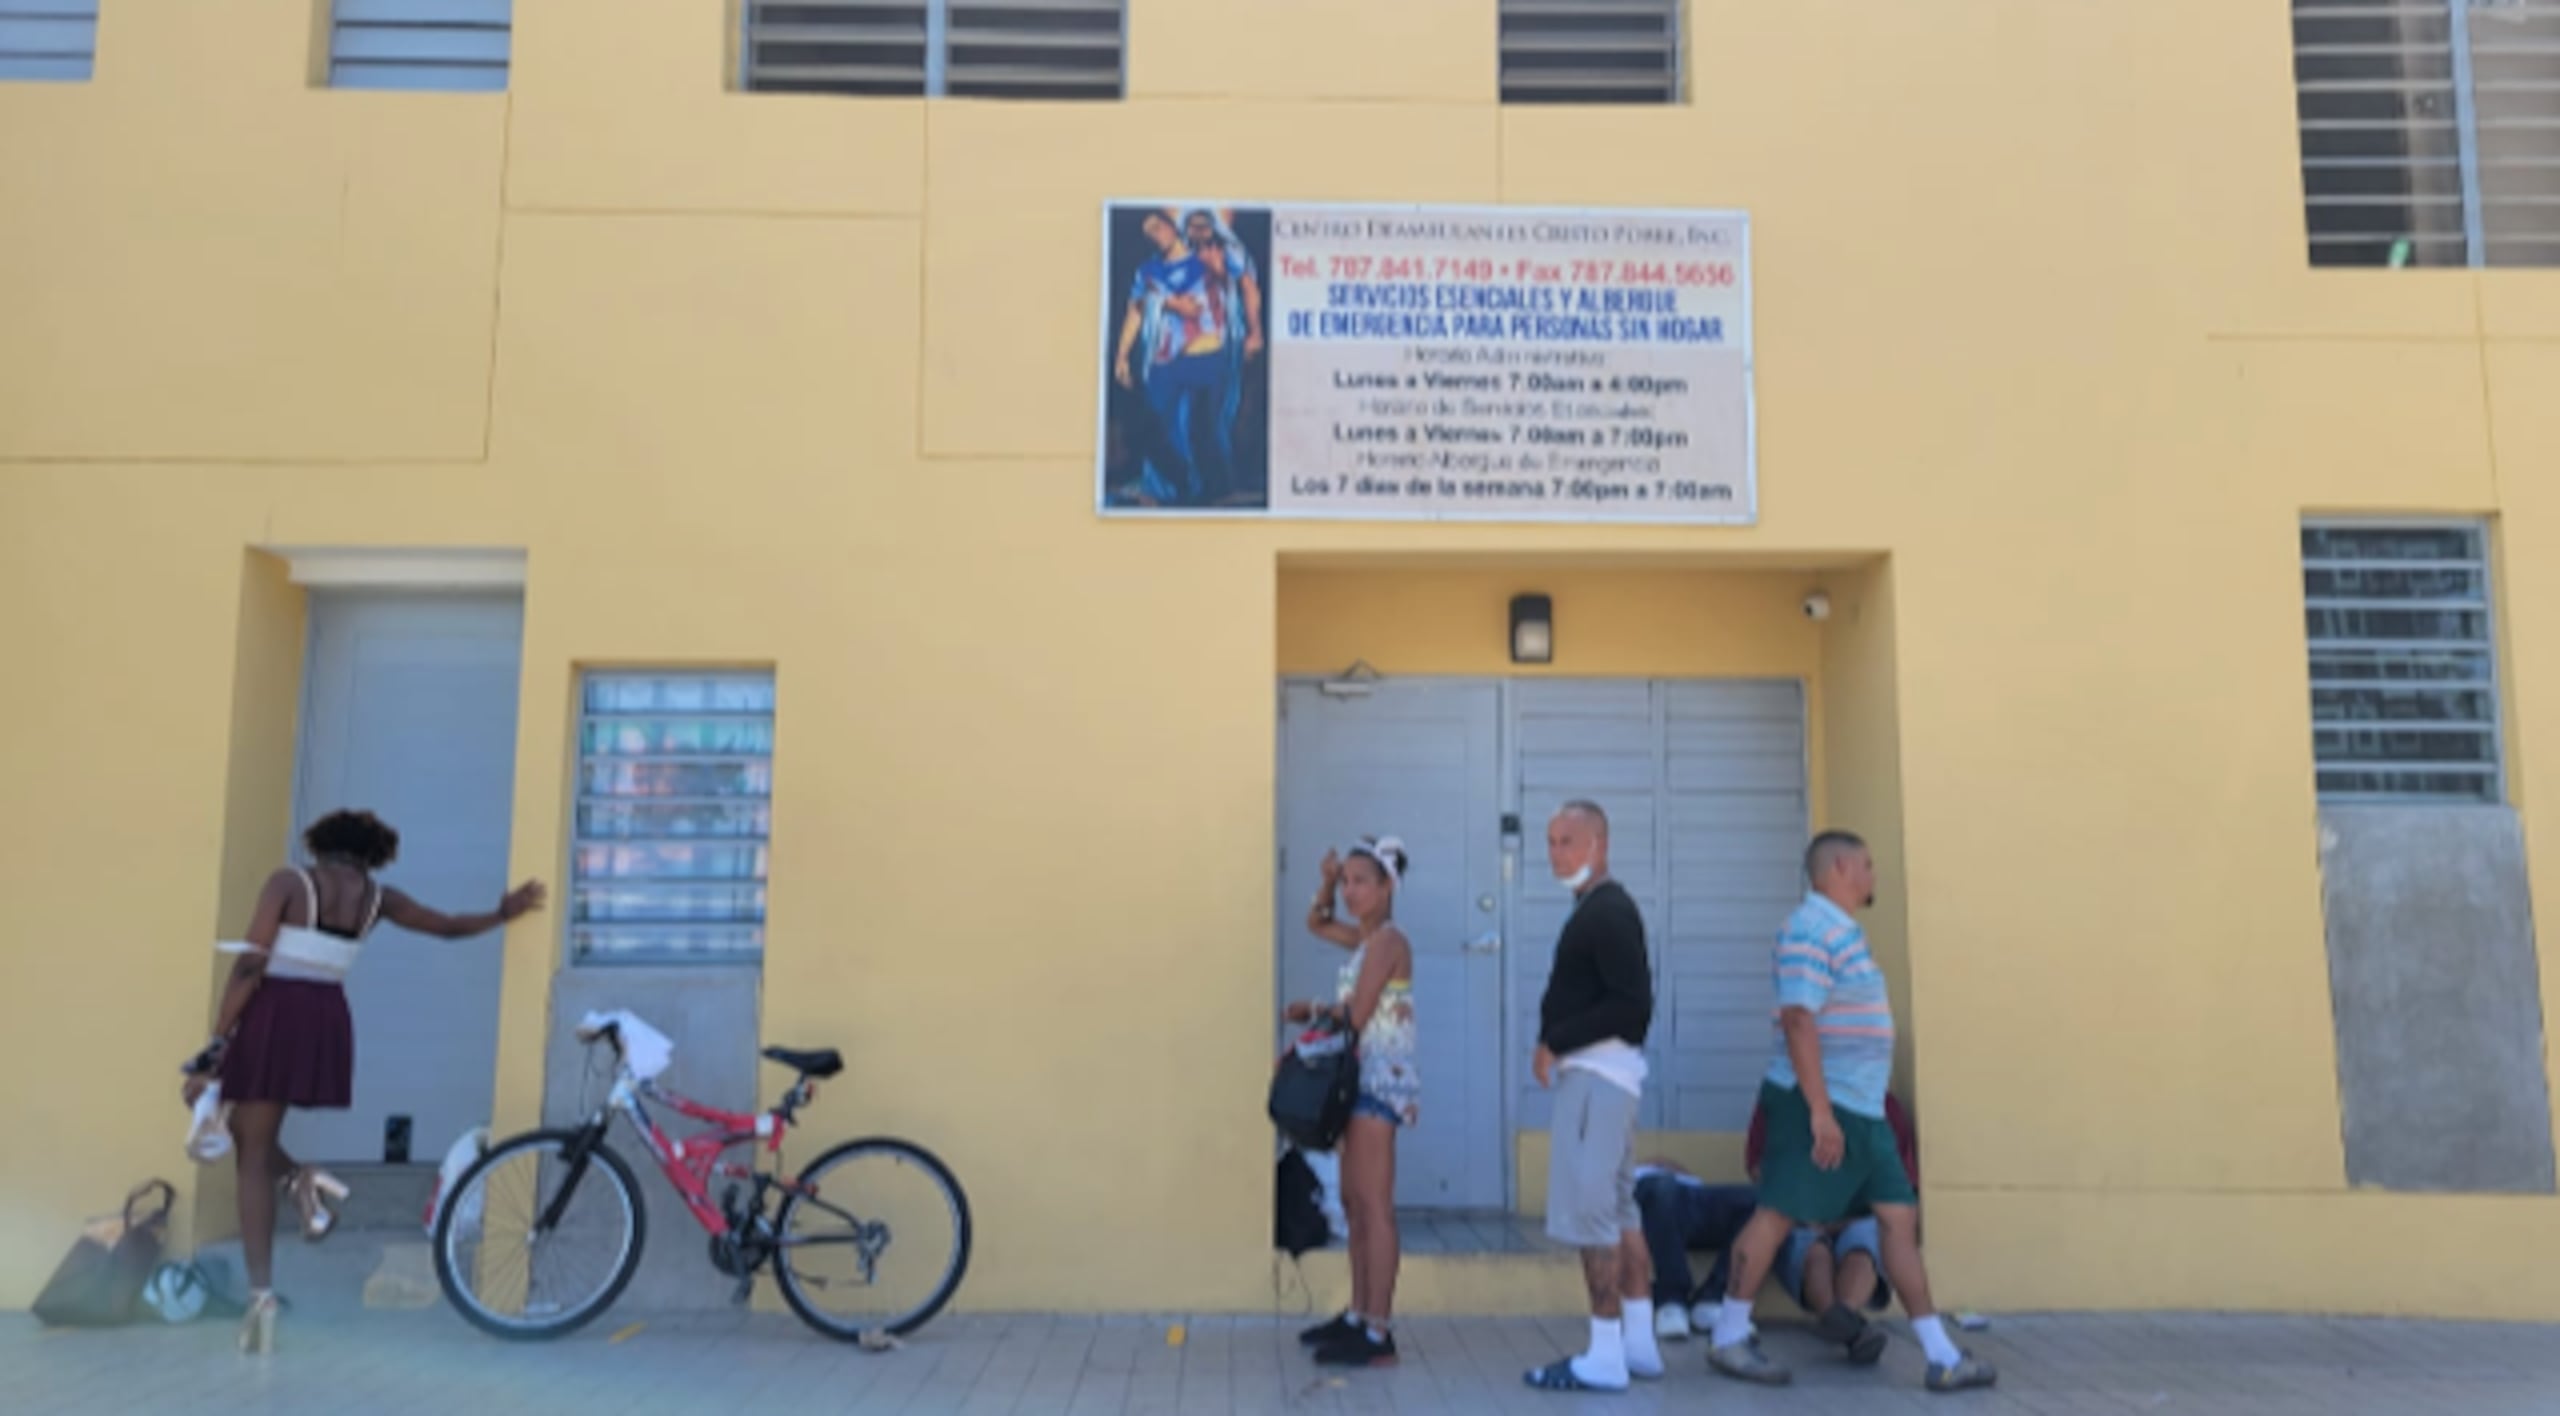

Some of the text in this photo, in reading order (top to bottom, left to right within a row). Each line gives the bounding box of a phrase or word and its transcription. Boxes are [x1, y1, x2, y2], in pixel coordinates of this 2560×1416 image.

[1279, 255, 1320, 279] Tel.
[1330, 255, 1493, 282] 787.841.7149
[1516, 259, 1561, 283] Fax
[1328, 283, 1677, 313] SERVICIOS ESENCIALES Y ALBERGUE
[1288, 310, 1724, 342] DE EMERGENCIA PARA PERSONAS SIN HOGAR
[1334, 371, 1398, 389] Lunes
[1405, 376, 1417, 389] a
[1423, 372, 1501, 390] Viernes
[1591, 379, 1603, 392] a
[1334, 423, 1398, 442] Lunes
[1405, 428, 1417, 442] a
[1423, 424, 1502, 443] Viernes
[1592, 431, 1603, 446] a
[1610, 427, 1689, 449] 7:00pm
[1291, 475, 1330, 495] Los
[1338, 475, 1349, 493] 7
[1405, 477, 1433, 496] de
[1437, 477, 1456, 496] la
[1463, 480, 1544, 497] semana
[1636, 485, 1647, 499] a
